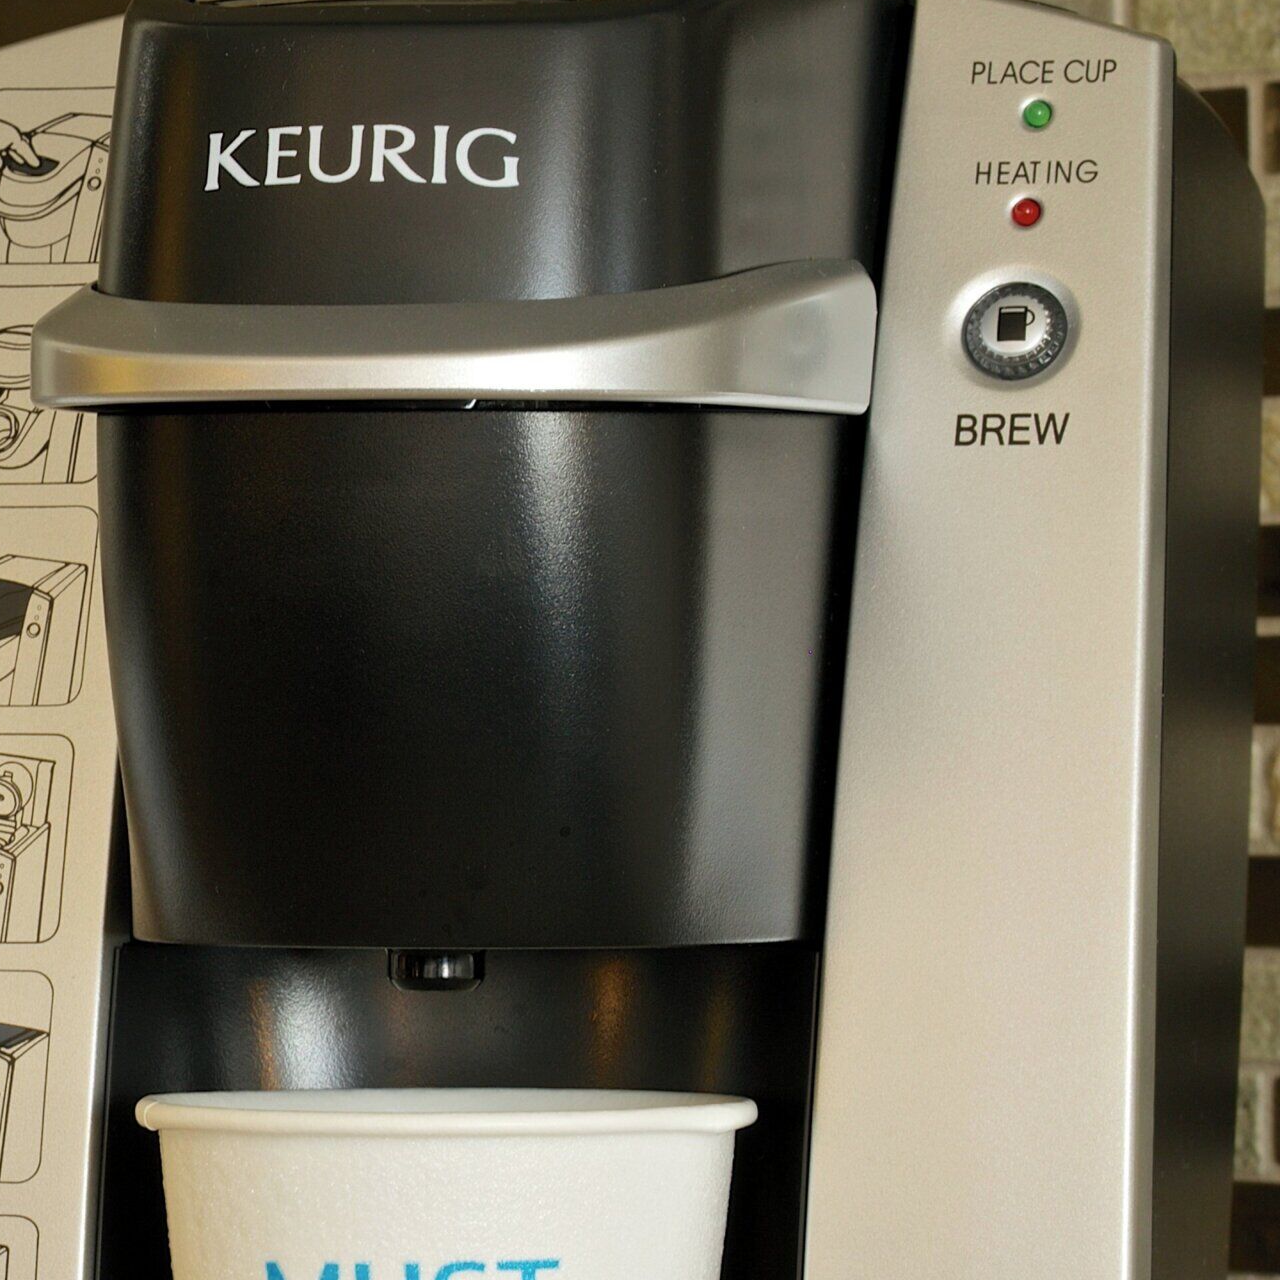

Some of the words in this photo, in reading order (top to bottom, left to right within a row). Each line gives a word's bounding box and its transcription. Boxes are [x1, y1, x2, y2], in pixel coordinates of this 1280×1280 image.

[972, 60, 1054, 84] PLACE
[1064, 59, 1117, 83] CUP
[205, 124, 519, 190] KEURIG
[976, 160, 1098, 185] HEATING
[955, 413, 1070, 446] BREW
